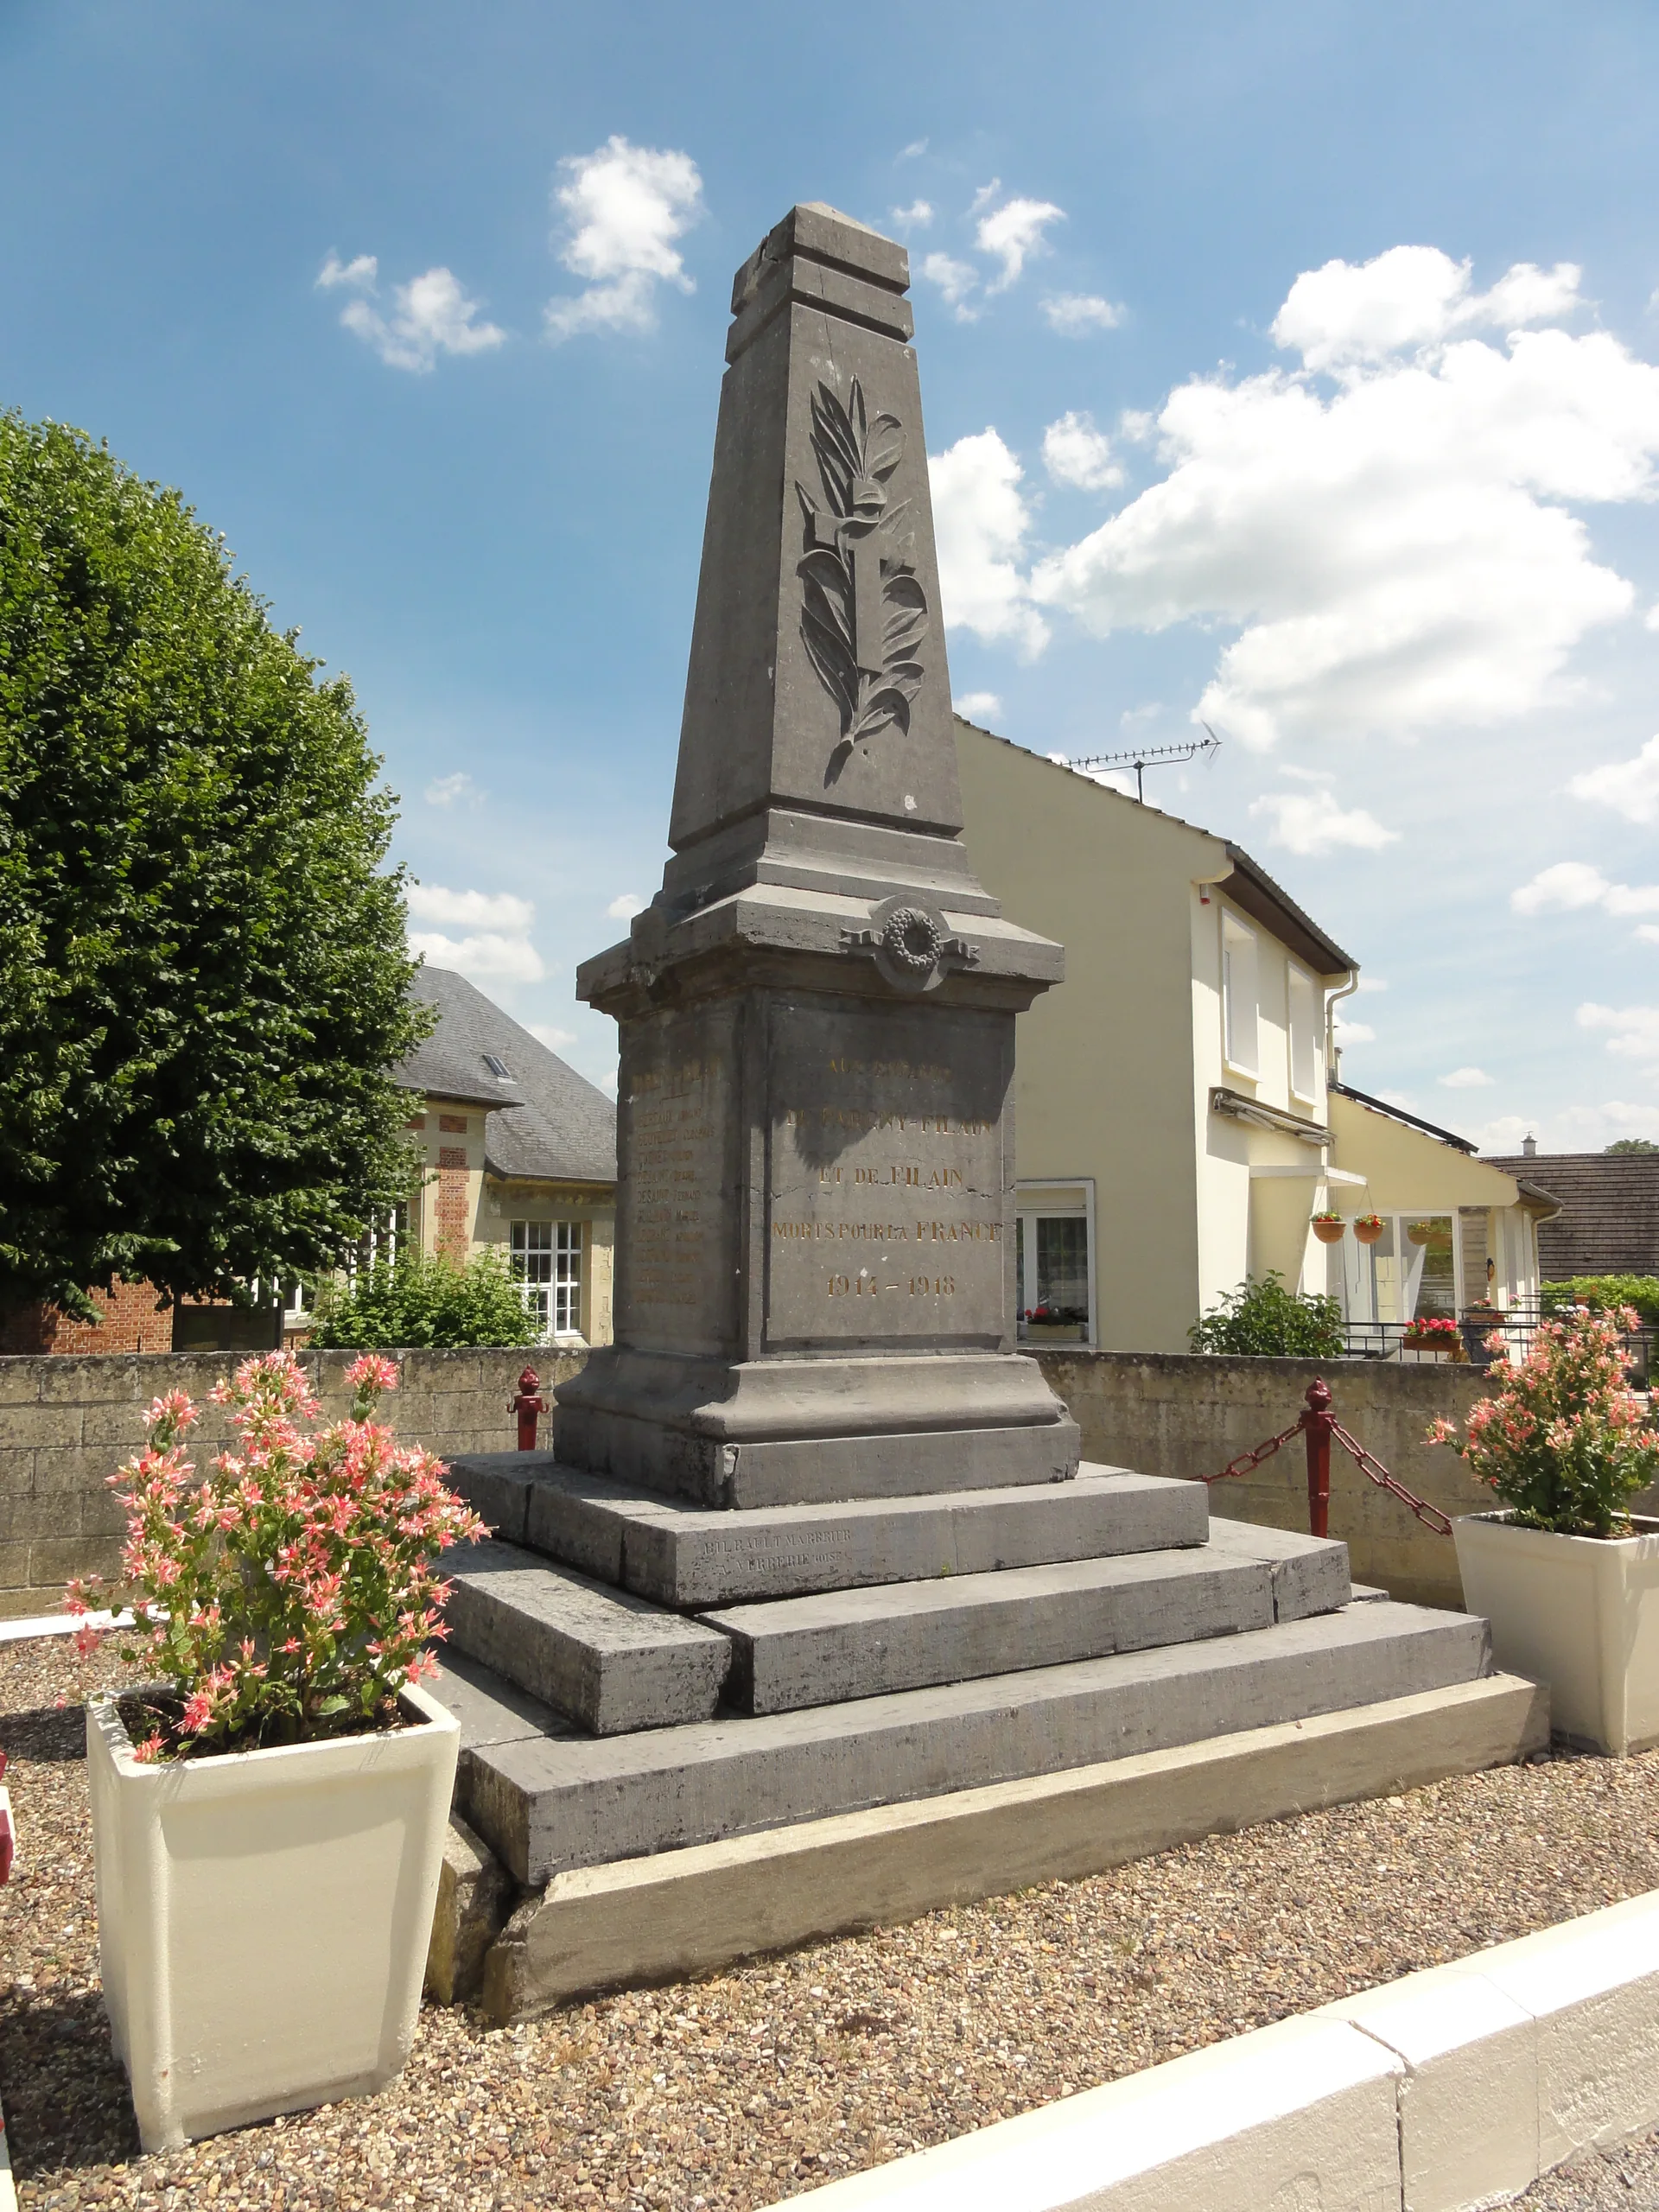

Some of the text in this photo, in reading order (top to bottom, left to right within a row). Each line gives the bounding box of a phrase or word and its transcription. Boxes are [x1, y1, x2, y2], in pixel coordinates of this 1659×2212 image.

[819, 1166, 963, 1189] ET DE FILAIN
[772, 1220, 1004, 1243] MORTS POUR LA FRANCE
[827, 1275, 879, 1298] 1914
[907, 1274, 956, 1298] 1918
